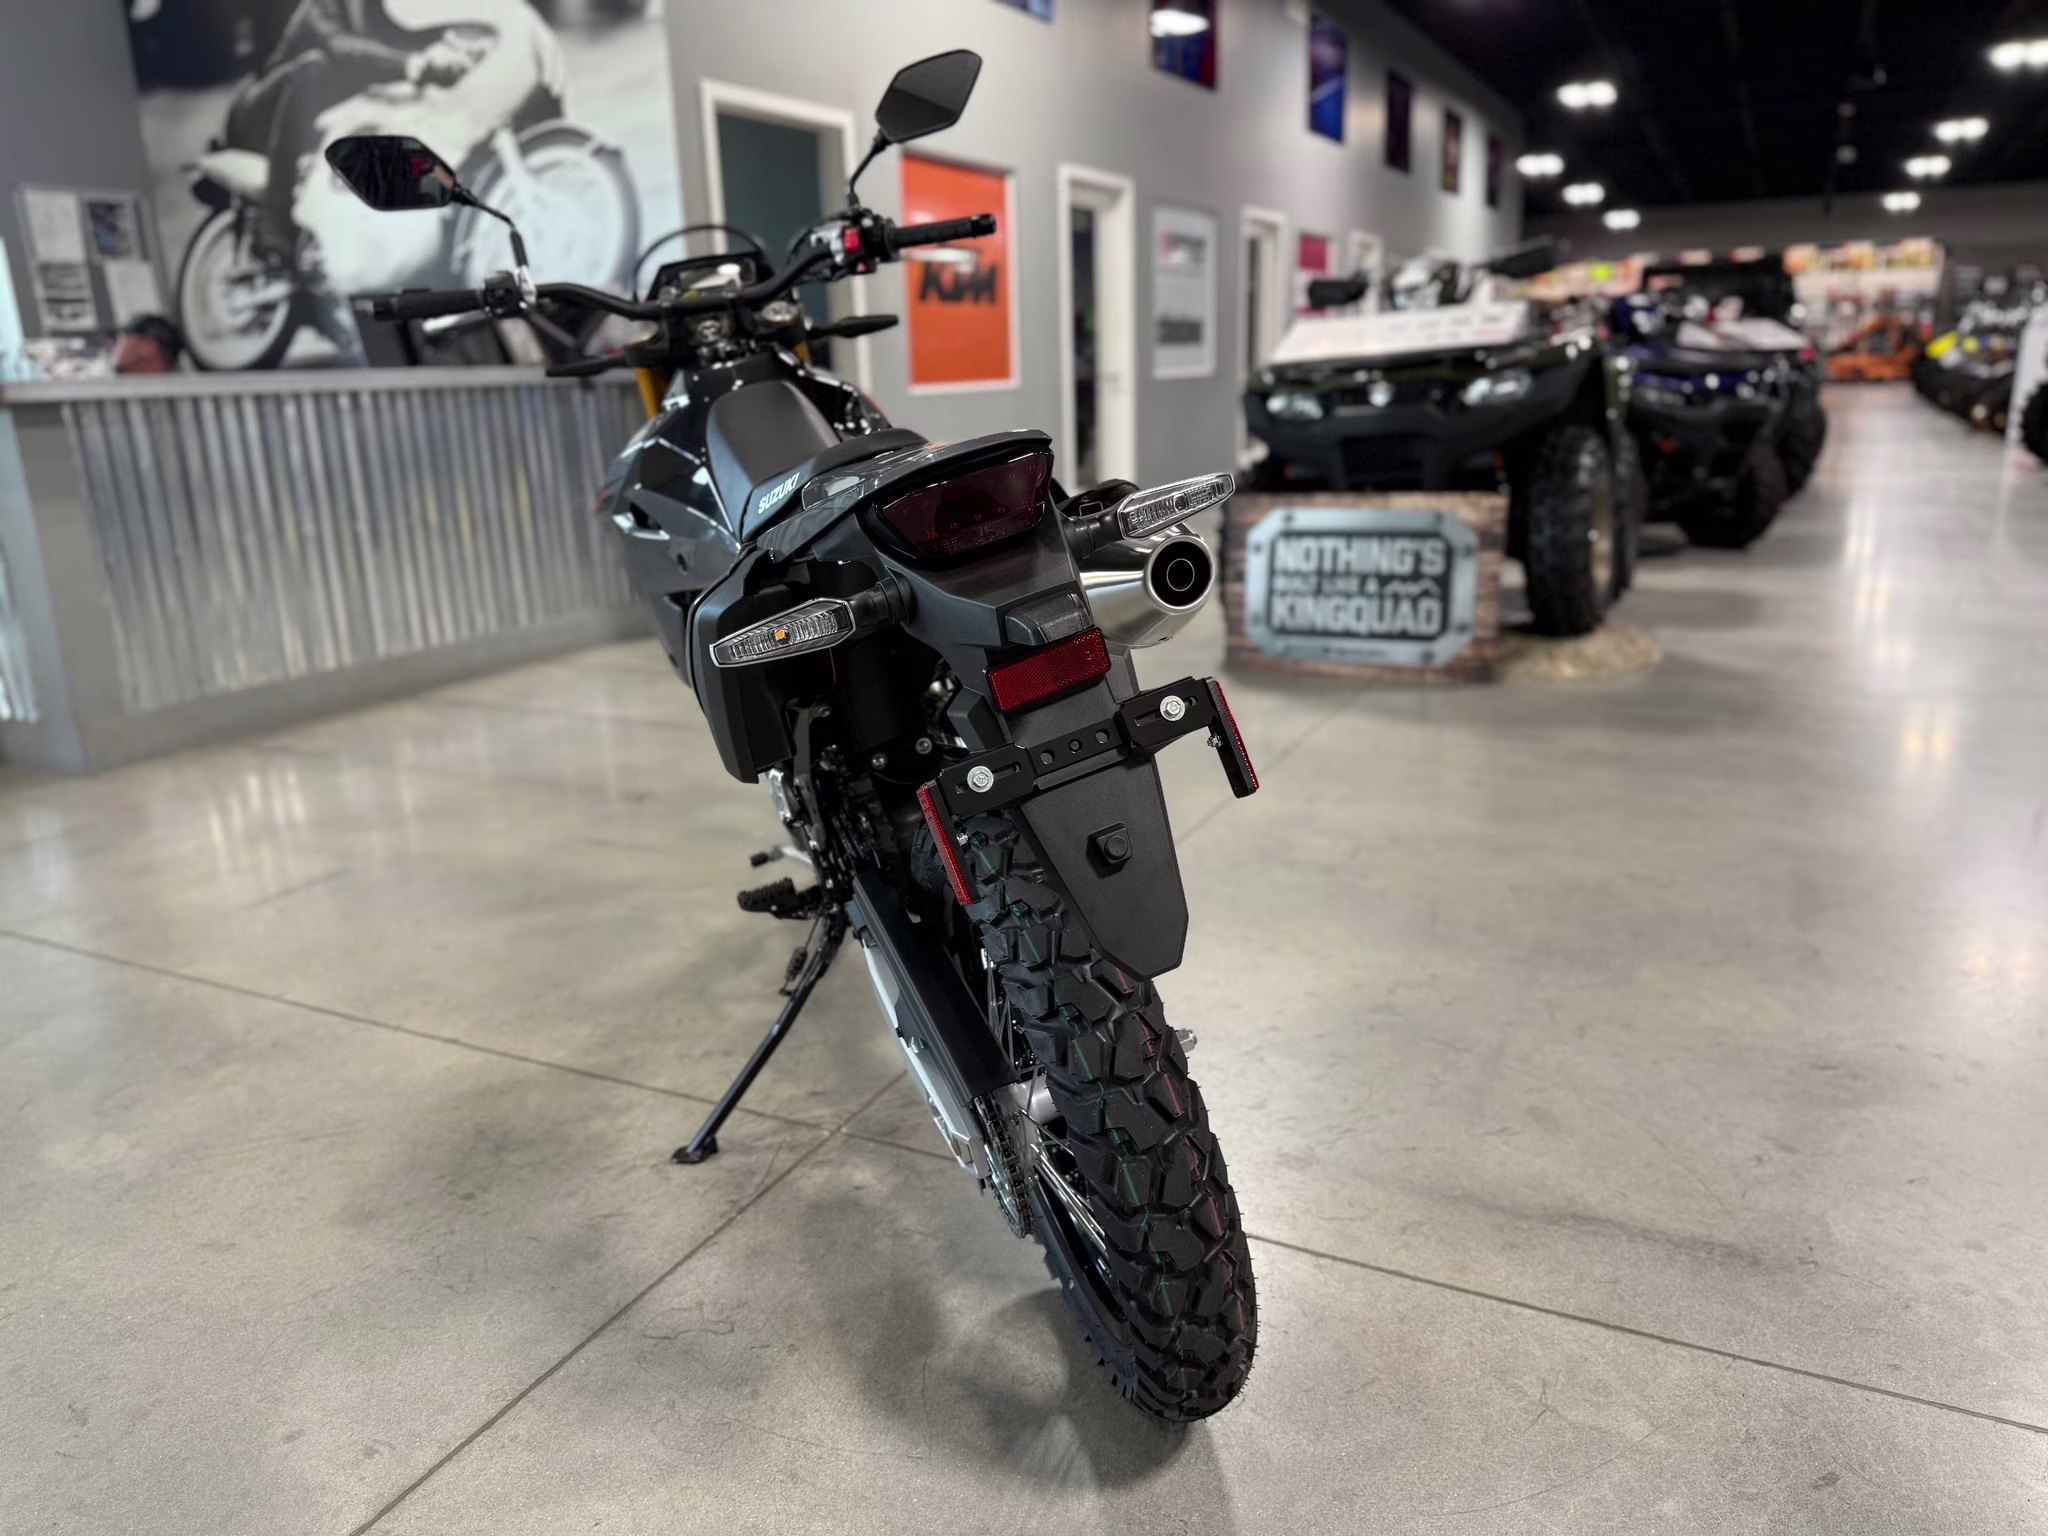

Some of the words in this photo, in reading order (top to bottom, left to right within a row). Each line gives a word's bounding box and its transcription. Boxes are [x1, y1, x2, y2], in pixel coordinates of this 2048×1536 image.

[919, 256, 997, 304] KTM
[757, 471, 800, 515] SUZUKI
[1273, 537, 1446, 576] NOTHING'S
[1271, 596, 1443, 636] KINGQUAD
